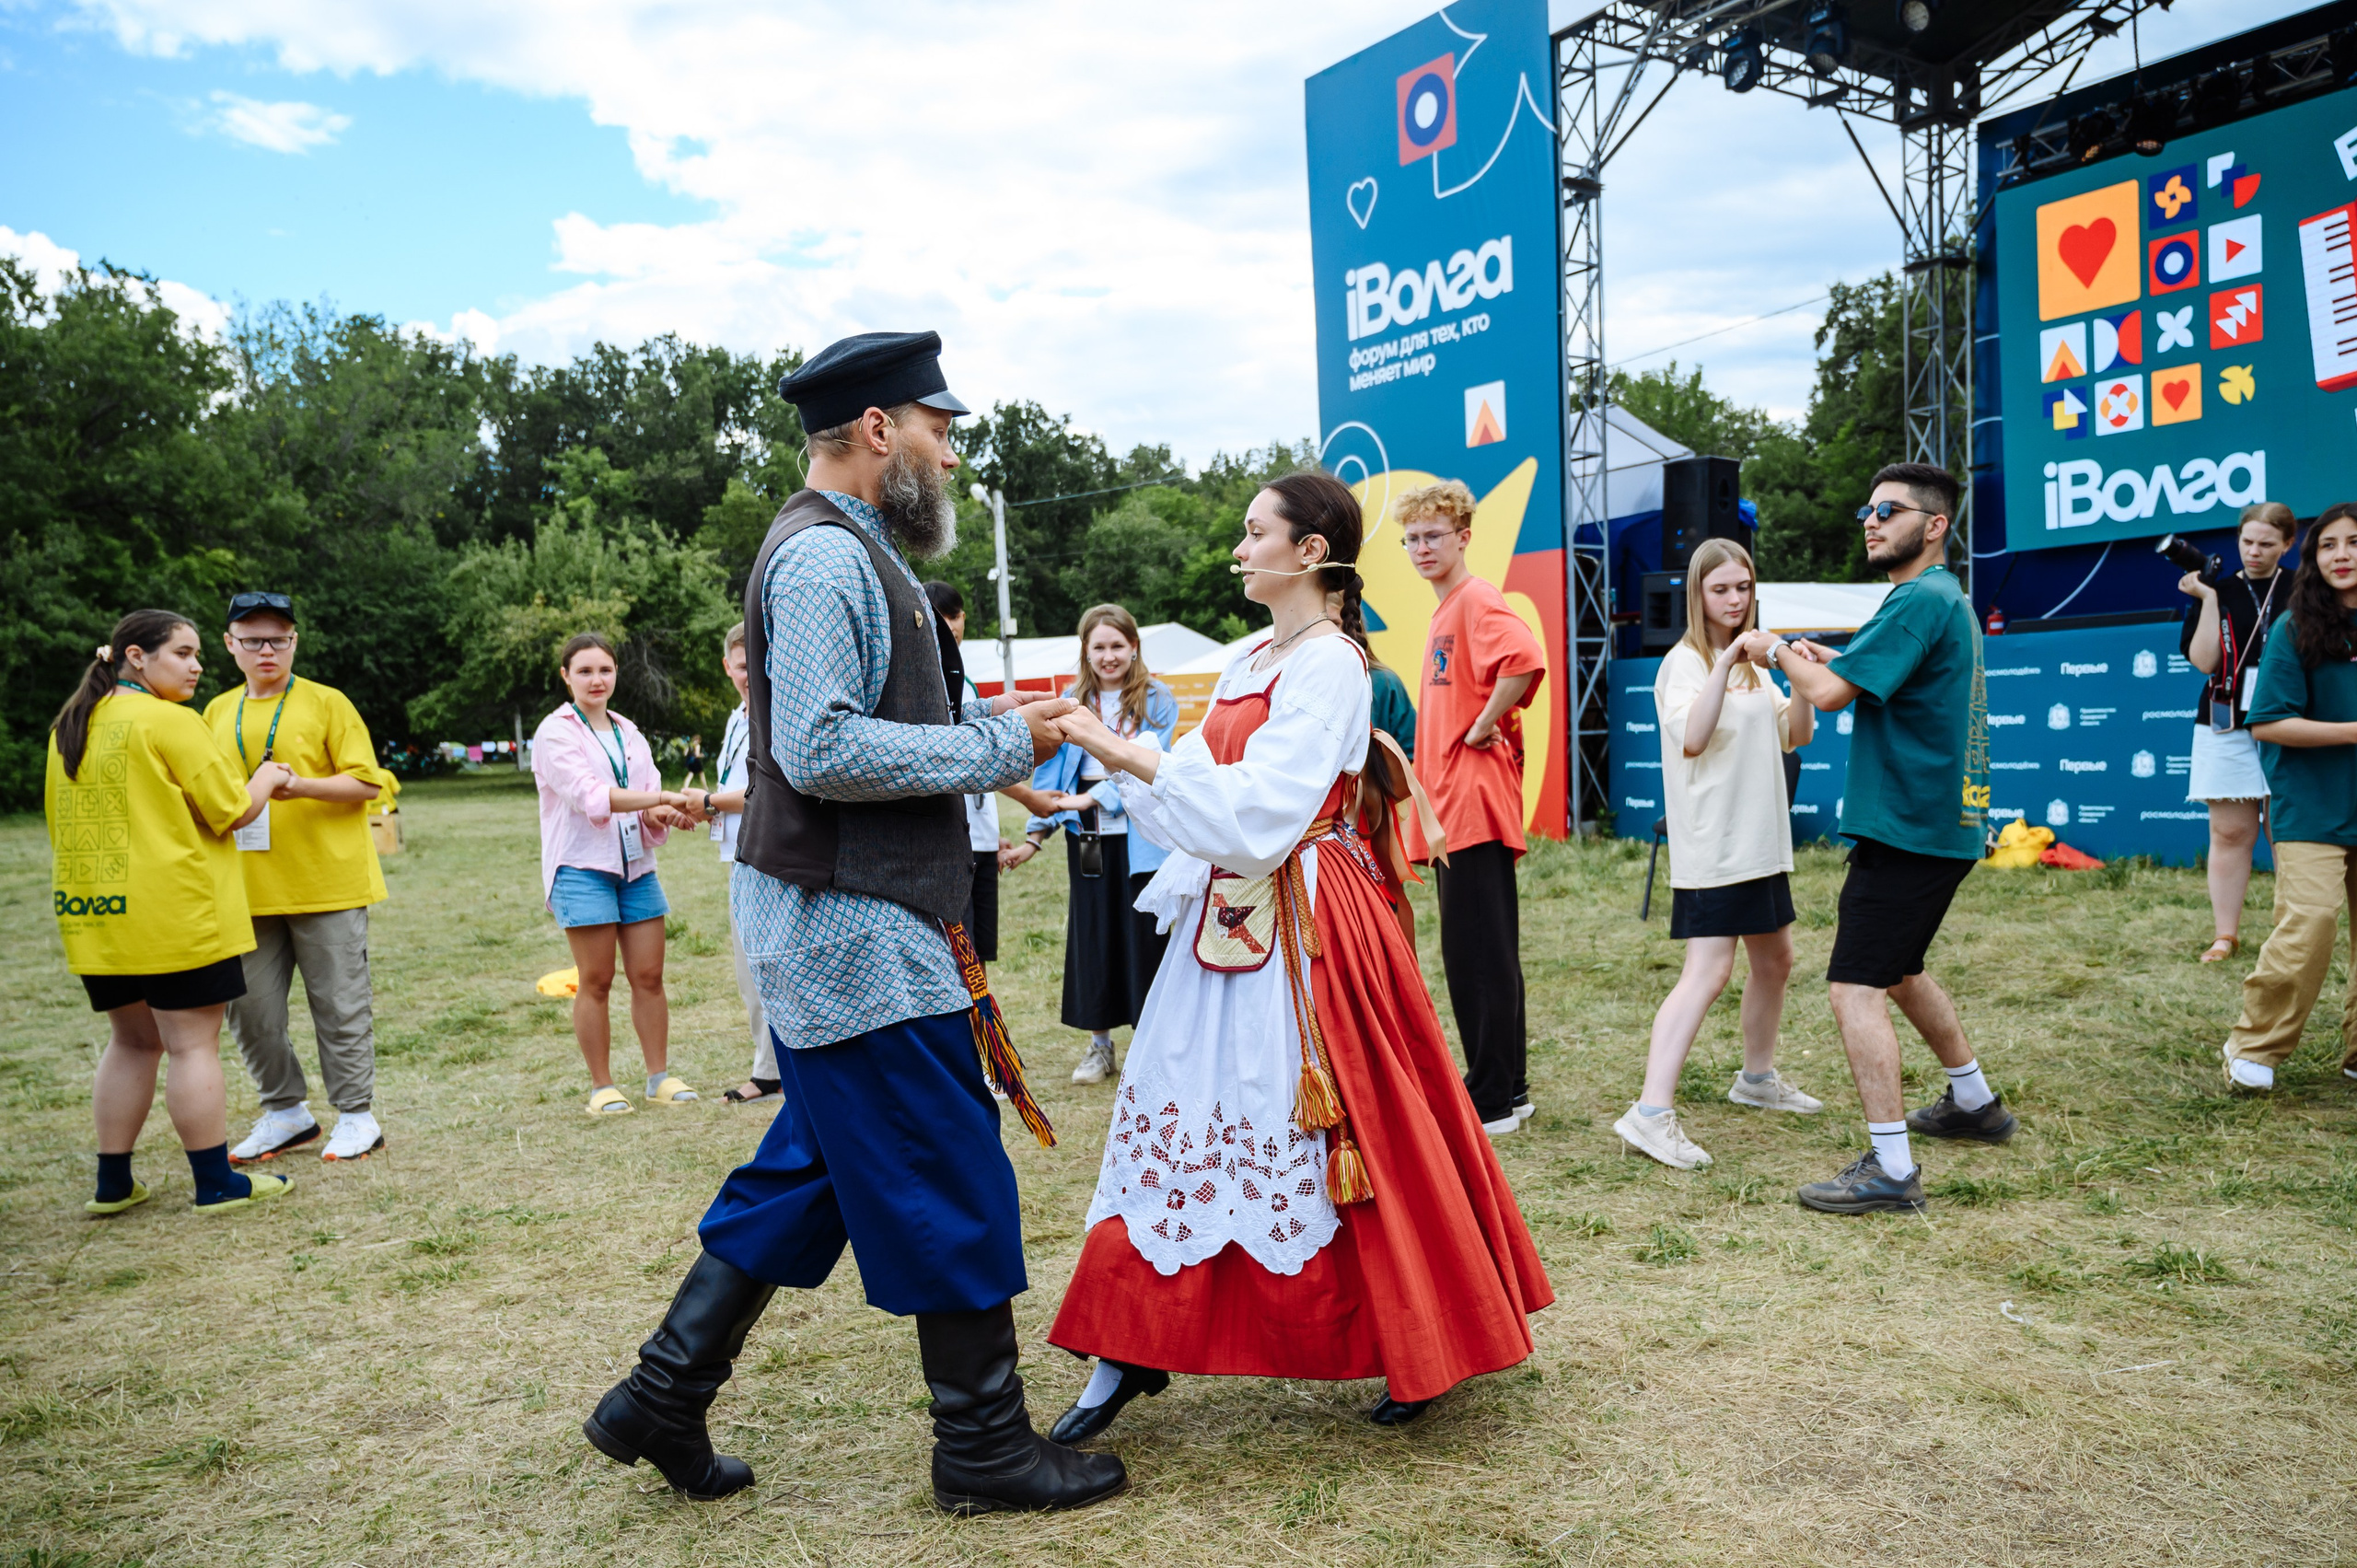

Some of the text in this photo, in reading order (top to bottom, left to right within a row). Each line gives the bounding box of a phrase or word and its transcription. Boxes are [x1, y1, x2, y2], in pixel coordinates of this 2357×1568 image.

[1349, 312, 1491, 372] форум для тех, кто
[1349, 353, 1436, 392] меняет мир
[1984, 667, 2041, 677] осмолодёжь
[2060, 662, 2108, 678] Первые
[1626, 721, 1655, 734] Первые
[1989, 761, 2040, 770] смолодёжь
[2059, 758, 2107, 774] Первые
[1626, 796, 1655, 809] Первые
[1988, 808, 2025, 820] ервые
[54, 890, 126, 916] Волга
